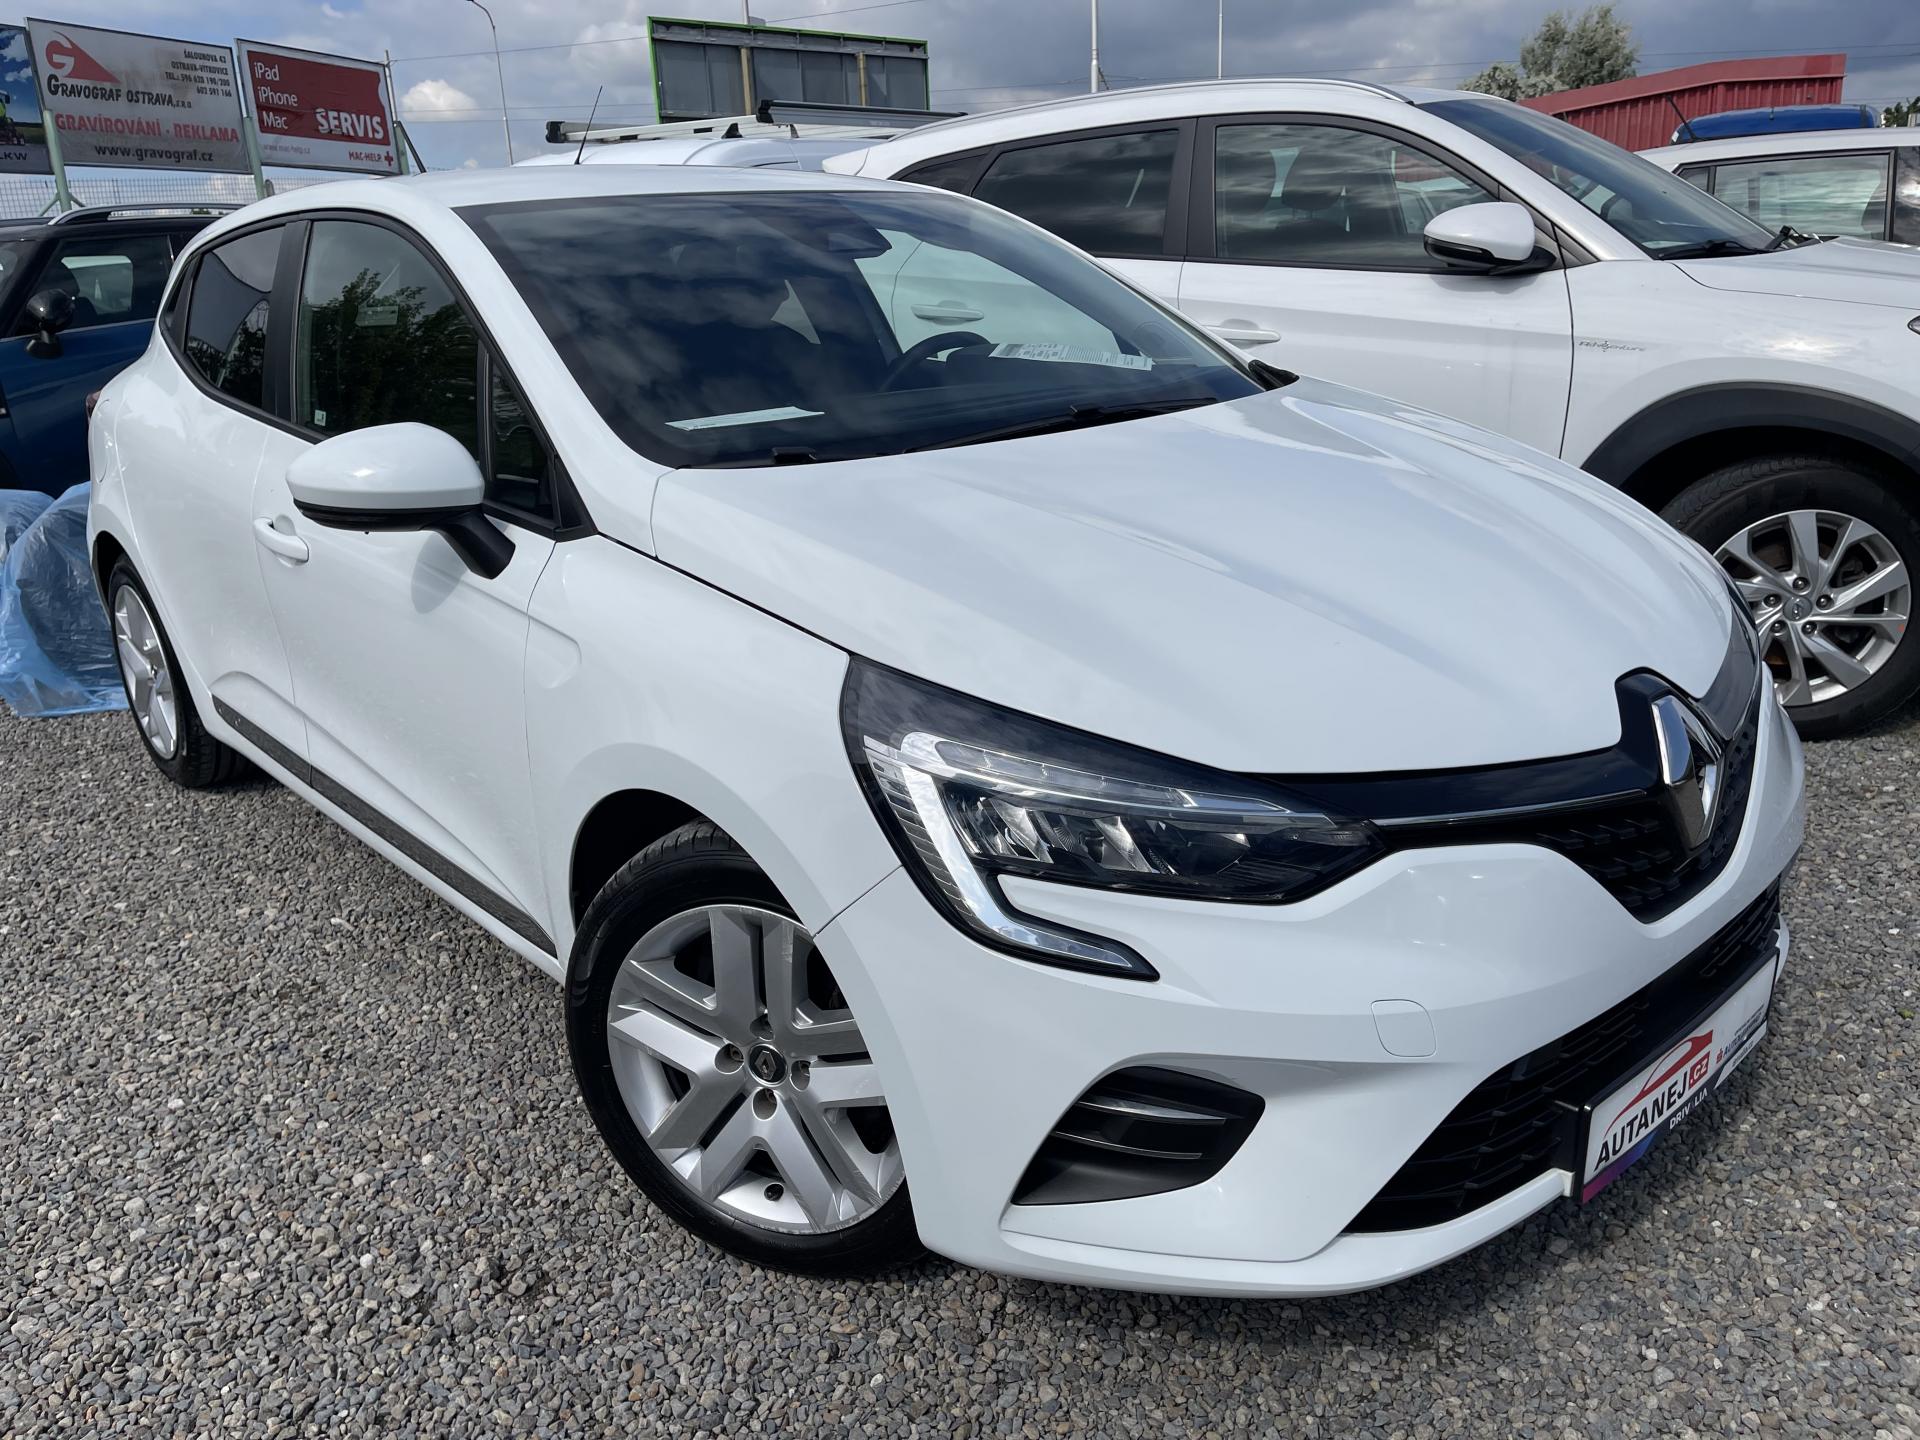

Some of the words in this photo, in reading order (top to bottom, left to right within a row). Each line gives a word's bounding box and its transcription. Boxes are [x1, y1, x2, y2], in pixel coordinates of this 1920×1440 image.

[254, 62, 280, 80] iPad
[47, 74, 122, 102] GRAVOGRAF
[258, 86, 298, 106] iPhone
[263, 111, 288, 129] Mac
[315, 108, 384, 139] SERVIS
[173, 123, 239, 142] REKLAMA
[95, 145, 213, 163] www.gravograf.cz
